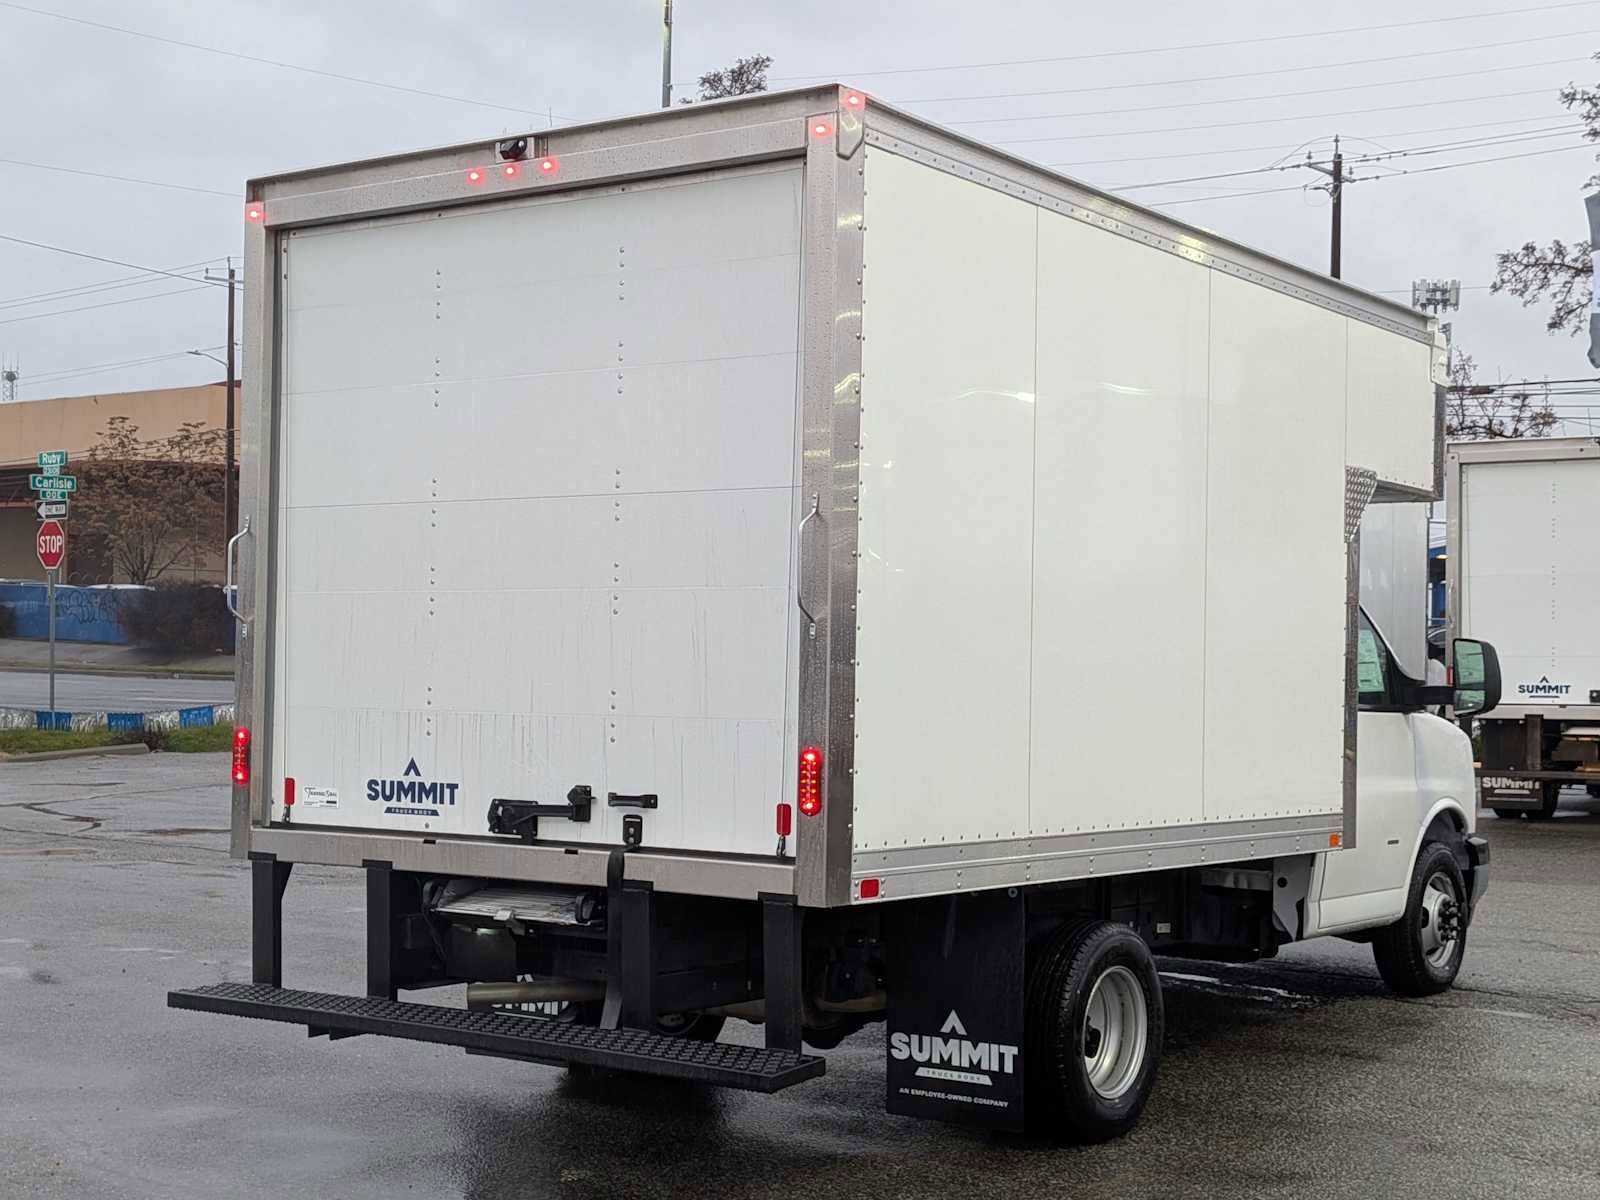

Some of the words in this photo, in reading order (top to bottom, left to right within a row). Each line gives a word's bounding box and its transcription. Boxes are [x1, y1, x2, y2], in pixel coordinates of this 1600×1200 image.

[42, 453, 61, 464] Ruby
[35, 477, 73, 489] Carlisle
[39, 535, 63, 554] STOP
[1518, 684, 1571, 694] SUMMIT
[366, 778, 459, 805] SUMMIT
[890, 1032, 1019, 1074] SUMMIT
[926, 1069, 955, 1079] TRUCK
[899, 1087, 910, 1095] AN
[973, 1096, 1009, 1108] COMPANY
